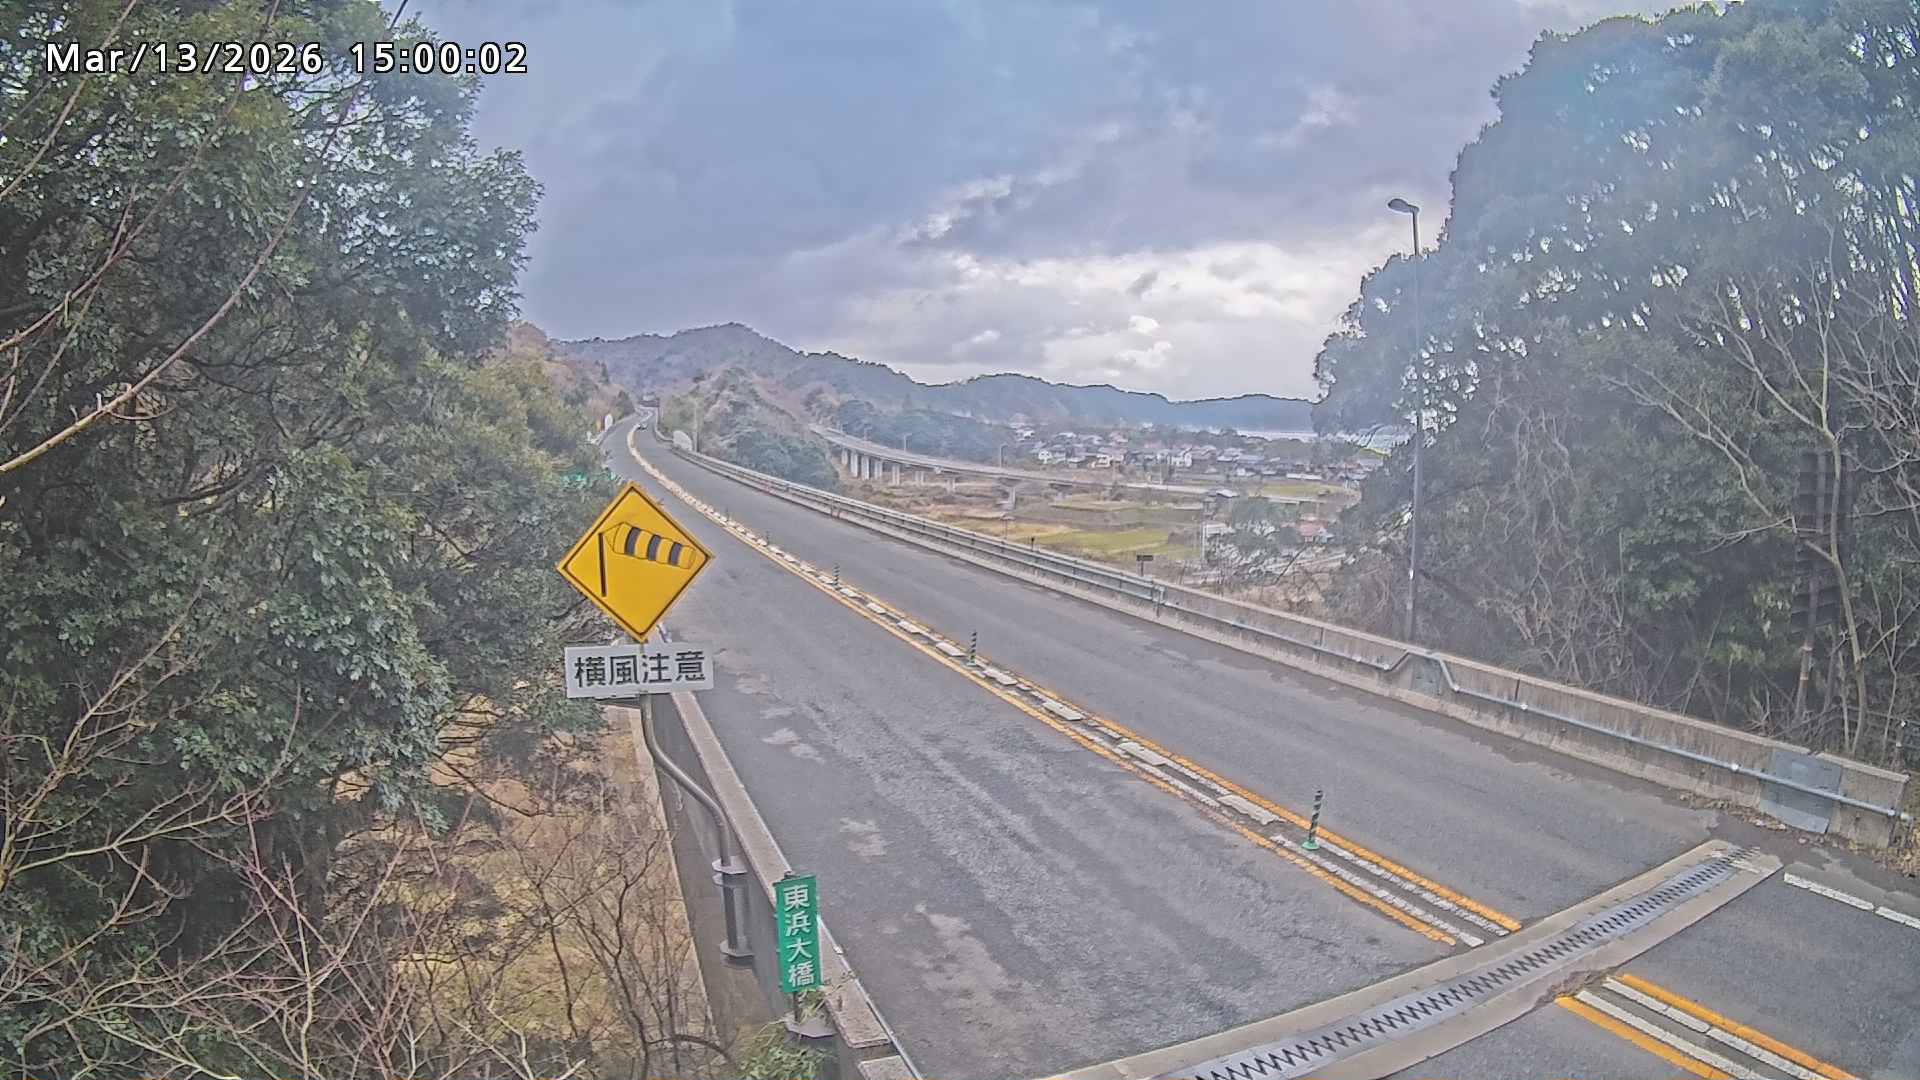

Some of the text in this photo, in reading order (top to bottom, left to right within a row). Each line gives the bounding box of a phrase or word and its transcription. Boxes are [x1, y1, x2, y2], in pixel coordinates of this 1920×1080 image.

[574, 651, 706, 688] 横風注意
[783, 884, 815, 987] 東浜大橋
